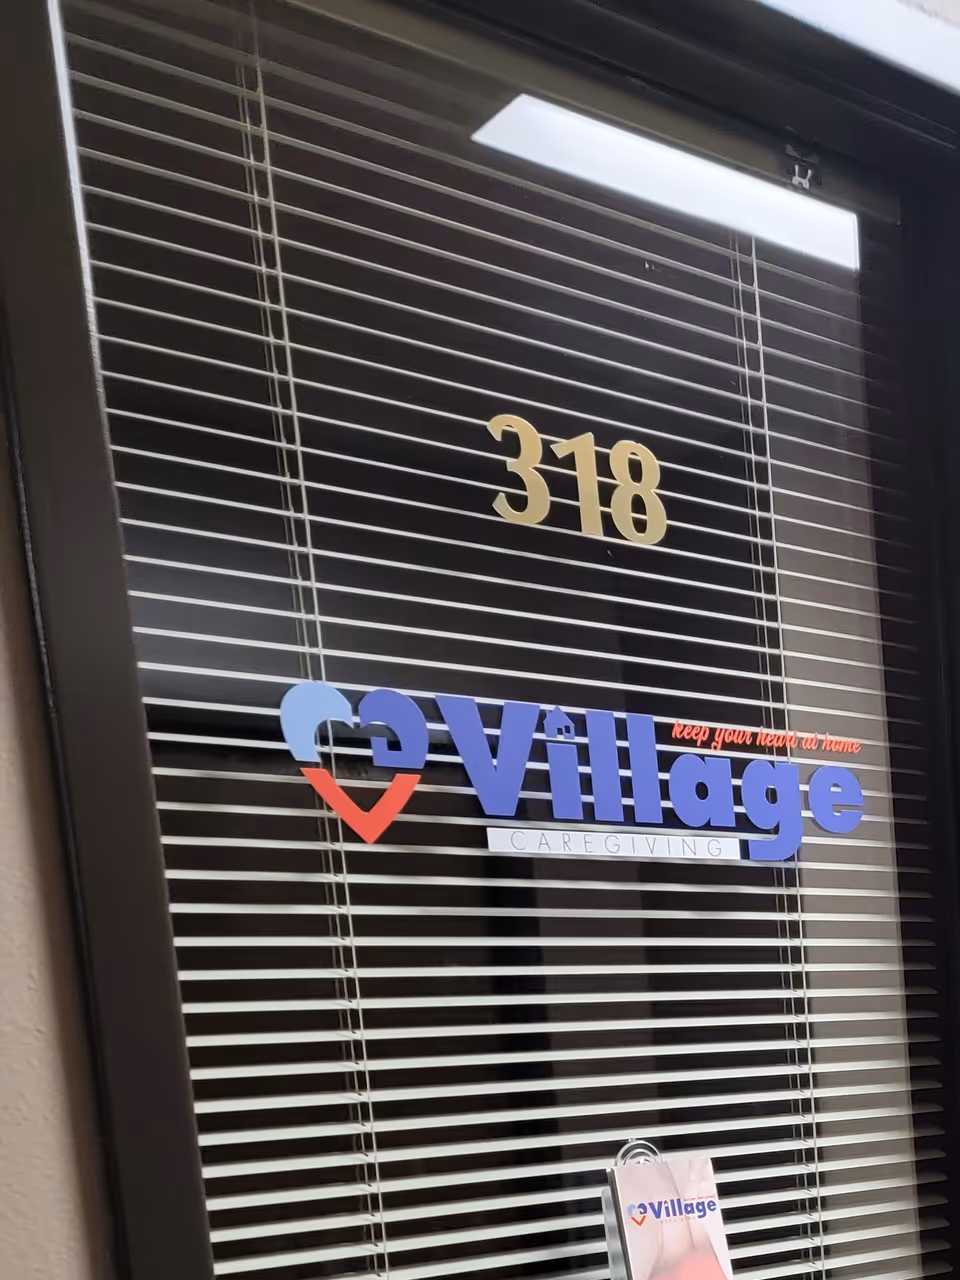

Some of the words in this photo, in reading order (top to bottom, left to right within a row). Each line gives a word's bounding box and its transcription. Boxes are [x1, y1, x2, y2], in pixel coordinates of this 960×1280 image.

[486, 414, 668, 545] 318
[671, 720, 710, 746] keep
[711, 727, 752, 751] your
[756, 726, 798, 749] heart
[802, 731, 818, 750] at
[821, 732, 862, 754] home
[435, 694, 866, 862] Village
[510, 830, 723, 857] CAREGIVING
[648, 1198, 717, 1219] Village
